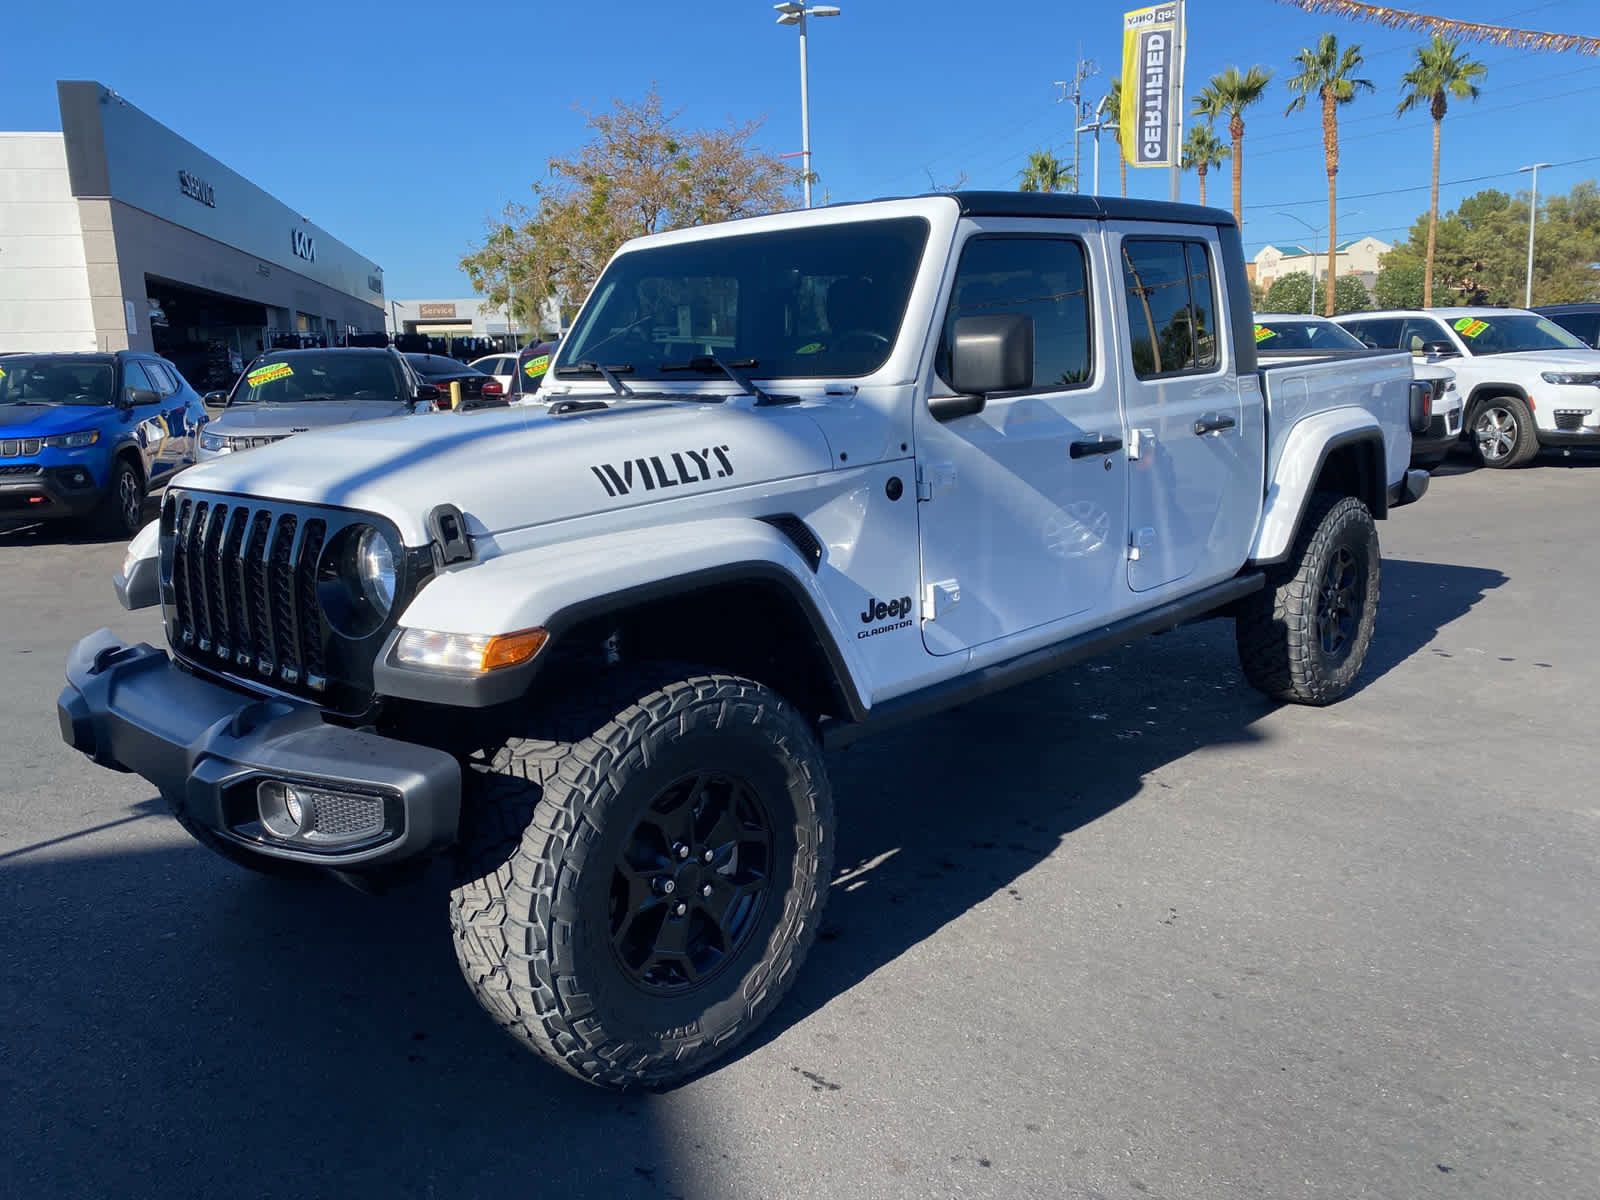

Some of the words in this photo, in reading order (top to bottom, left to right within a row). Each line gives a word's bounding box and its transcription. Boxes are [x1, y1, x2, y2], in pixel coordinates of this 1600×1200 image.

[291, 228, 316, 263] KIA
[421, 305, 454, 315] Service
[590, 445, 734, 496] WILLYS
[861, 596, 912, 623] Jeep
[857, 619, 913, 639] GLADIATOR
